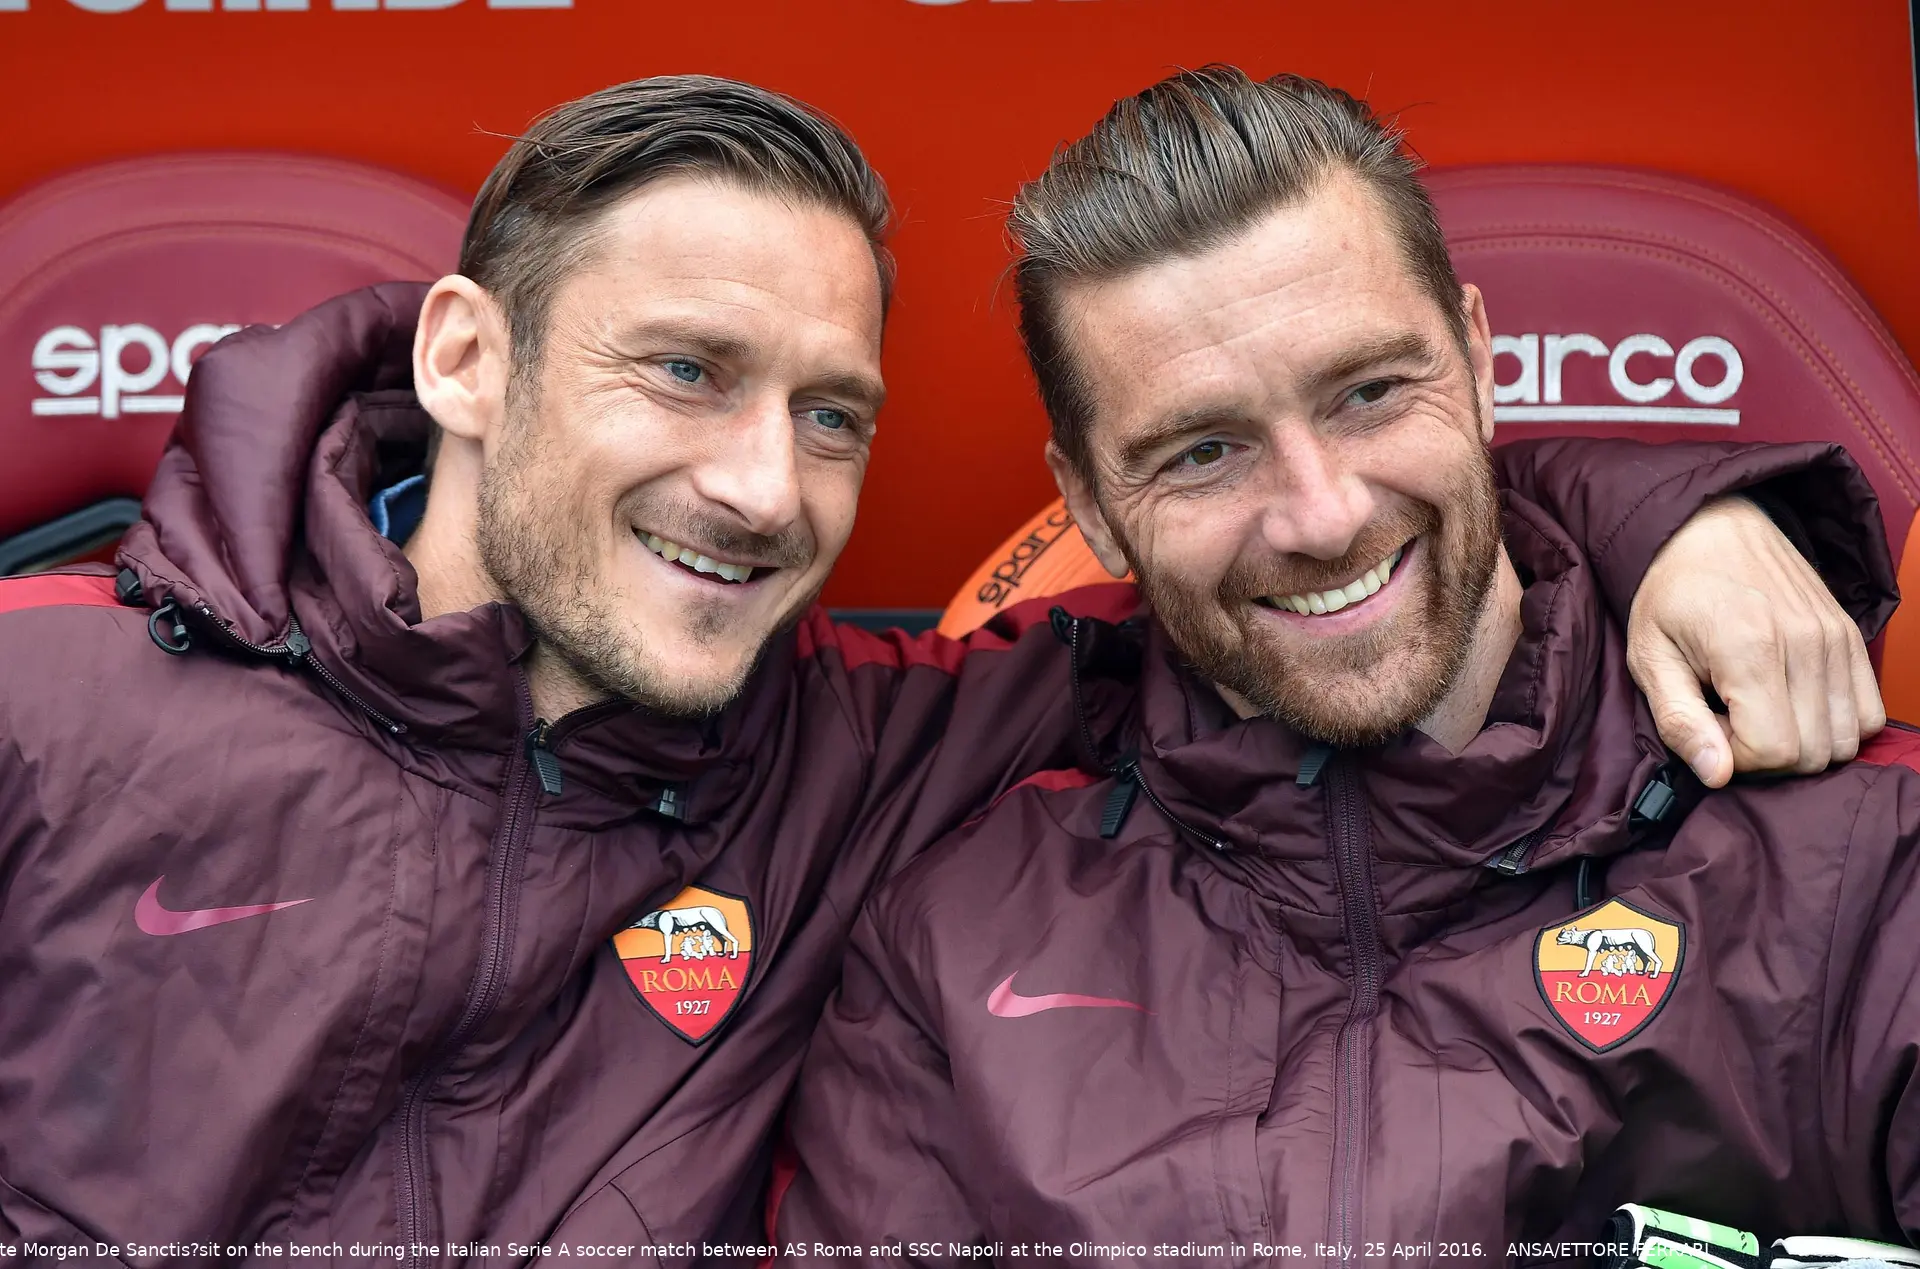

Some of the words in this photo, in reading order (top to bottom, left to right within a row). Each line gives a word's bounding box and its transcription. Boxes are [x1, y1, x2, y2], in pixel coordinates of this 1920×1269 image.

[640, 967, 738, 993] ROMA
[1554, 981, 1653, 1007] ROMA
[675, 1000, 711, 1015] 1927
[1583, 1011, 1622, 1026] 1927
